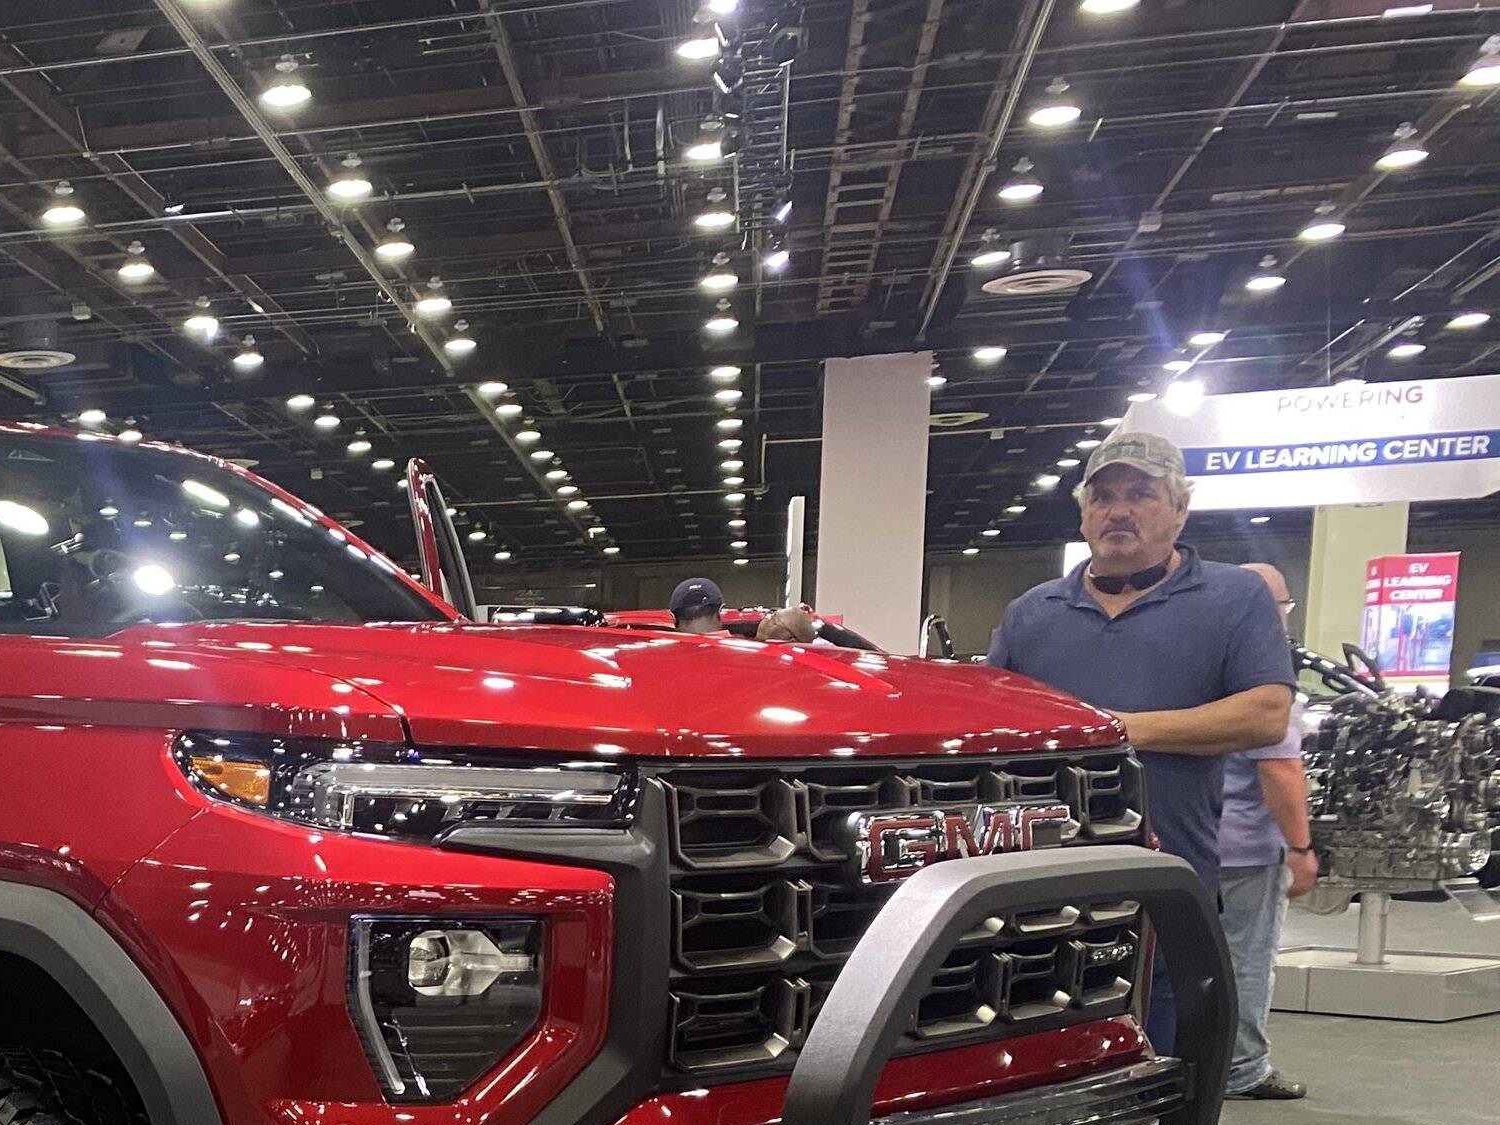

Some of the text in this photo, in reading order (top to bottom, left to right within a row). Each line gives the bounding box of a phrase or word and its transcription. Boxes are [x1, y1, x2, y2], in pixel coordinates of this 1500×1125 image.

[1277, 385, 1424, 413] POWERING
[1205, 434, 1491, 471] EV LEARNING CENTER
[1408, 562, 1430, 574] EV
[1383, 574, 1453, 588] LEARNING
[1389, 588, 1444, 600] CENTER
